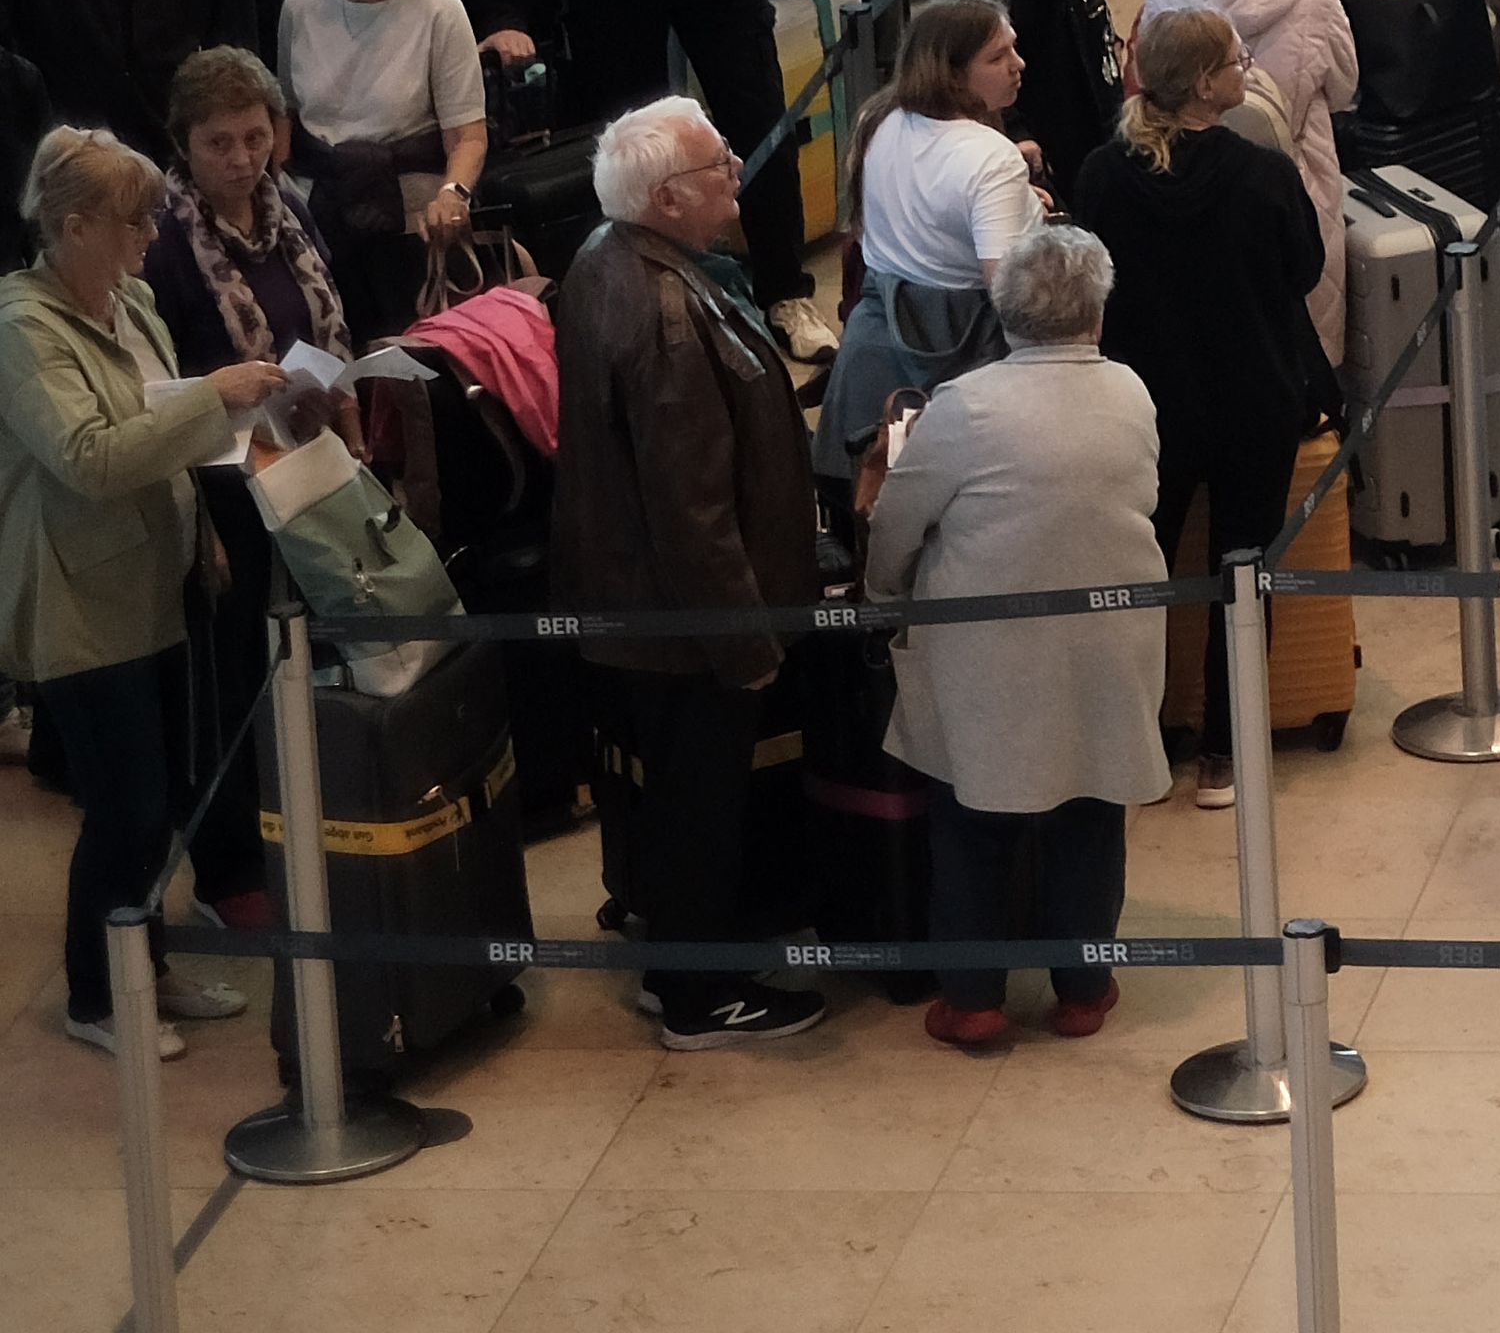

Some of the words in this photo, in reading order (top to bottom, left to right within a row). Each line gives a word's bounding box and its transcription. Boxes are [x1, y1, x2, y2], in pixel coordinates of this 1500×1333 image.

[1090, 590, 1133, 613] BER
[538, 618, 579, 634] BER
[815, 609, 856, 626] BER
[490, 943, 533, 962] BER
[787, 946, 831, 964] BER
[1083, 944, 1128, 962] BER
